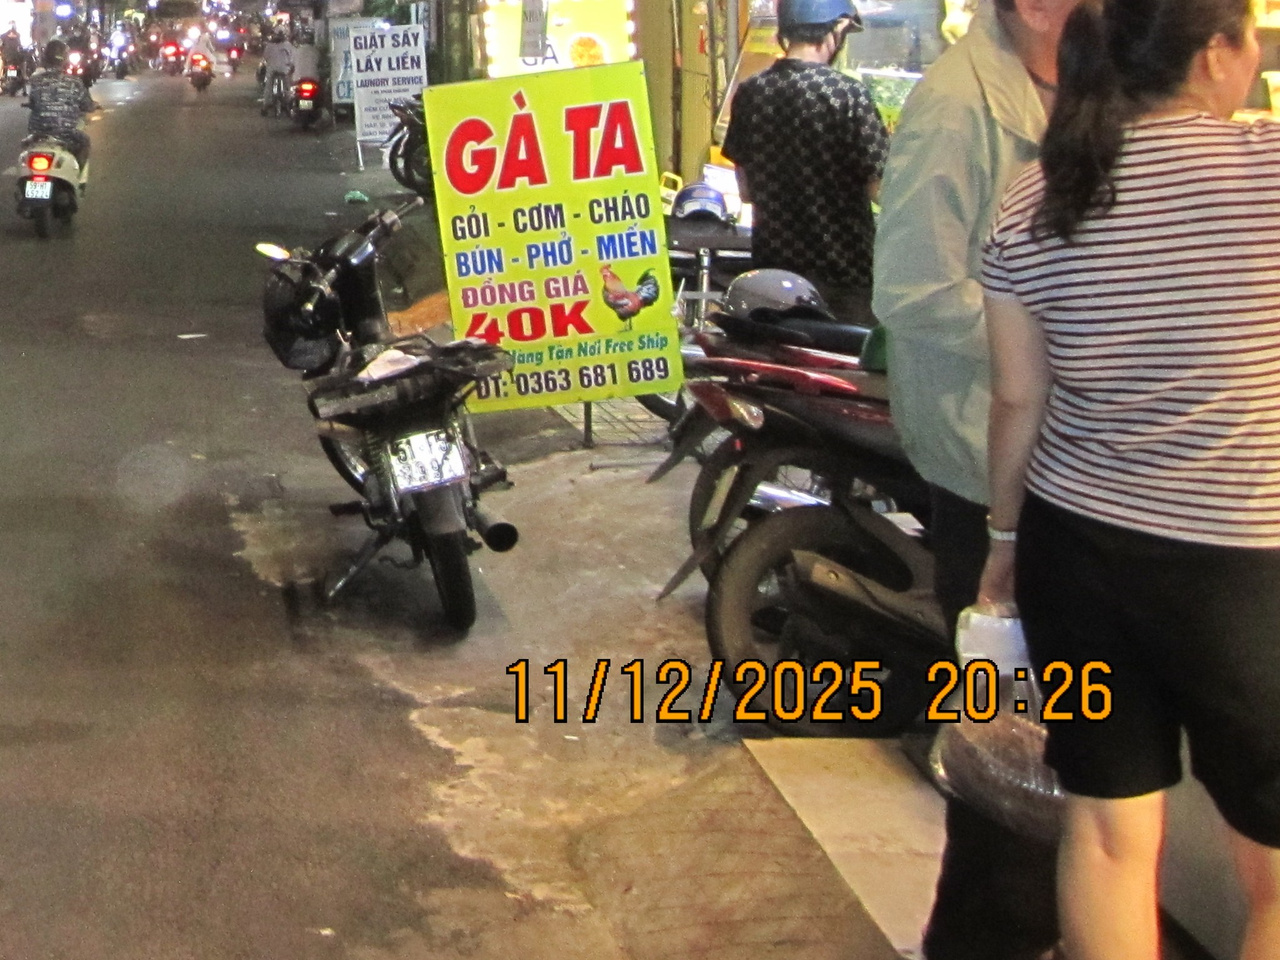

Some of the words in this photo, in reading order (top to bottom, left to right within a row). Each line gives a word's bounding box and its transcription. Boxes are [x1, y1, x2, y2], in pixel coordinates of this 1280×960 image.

[353, 31, 387, 50] GIẶT
[391, 27, 421, 49] SẤY
[356, 50, 383, 73] LẤY
[356, 77, 390, 89] LAUNDRY
[391, 75, 424, 86] SERVICE
[444, 91, 549, 195] GÀ
[564, 100, 645, 181] TA
[451, 205, 490, 241] GỎI
[512, 201, 566, 234] CƠM
[588, 190, 651, 225] CHÁO
[455, 245, 504, 278] BÚN
[526, 230, 574, 270] PHỞ
[595, 222, 658, 261] MIẾN
[461, 277, 535, 309] ĐỒNG
[543, 270, 590, 298] GIÁ
[464, 299, 596, 347] 40K
[547, 341, 575, 365] Tận
[604, 337, 634, 355] Free
[637, 331, 669, 351] Ship
[514, 367, 572, 396] 0363
[578, 362, 619, 389] 681
[626, 356, 670, 384] 689
